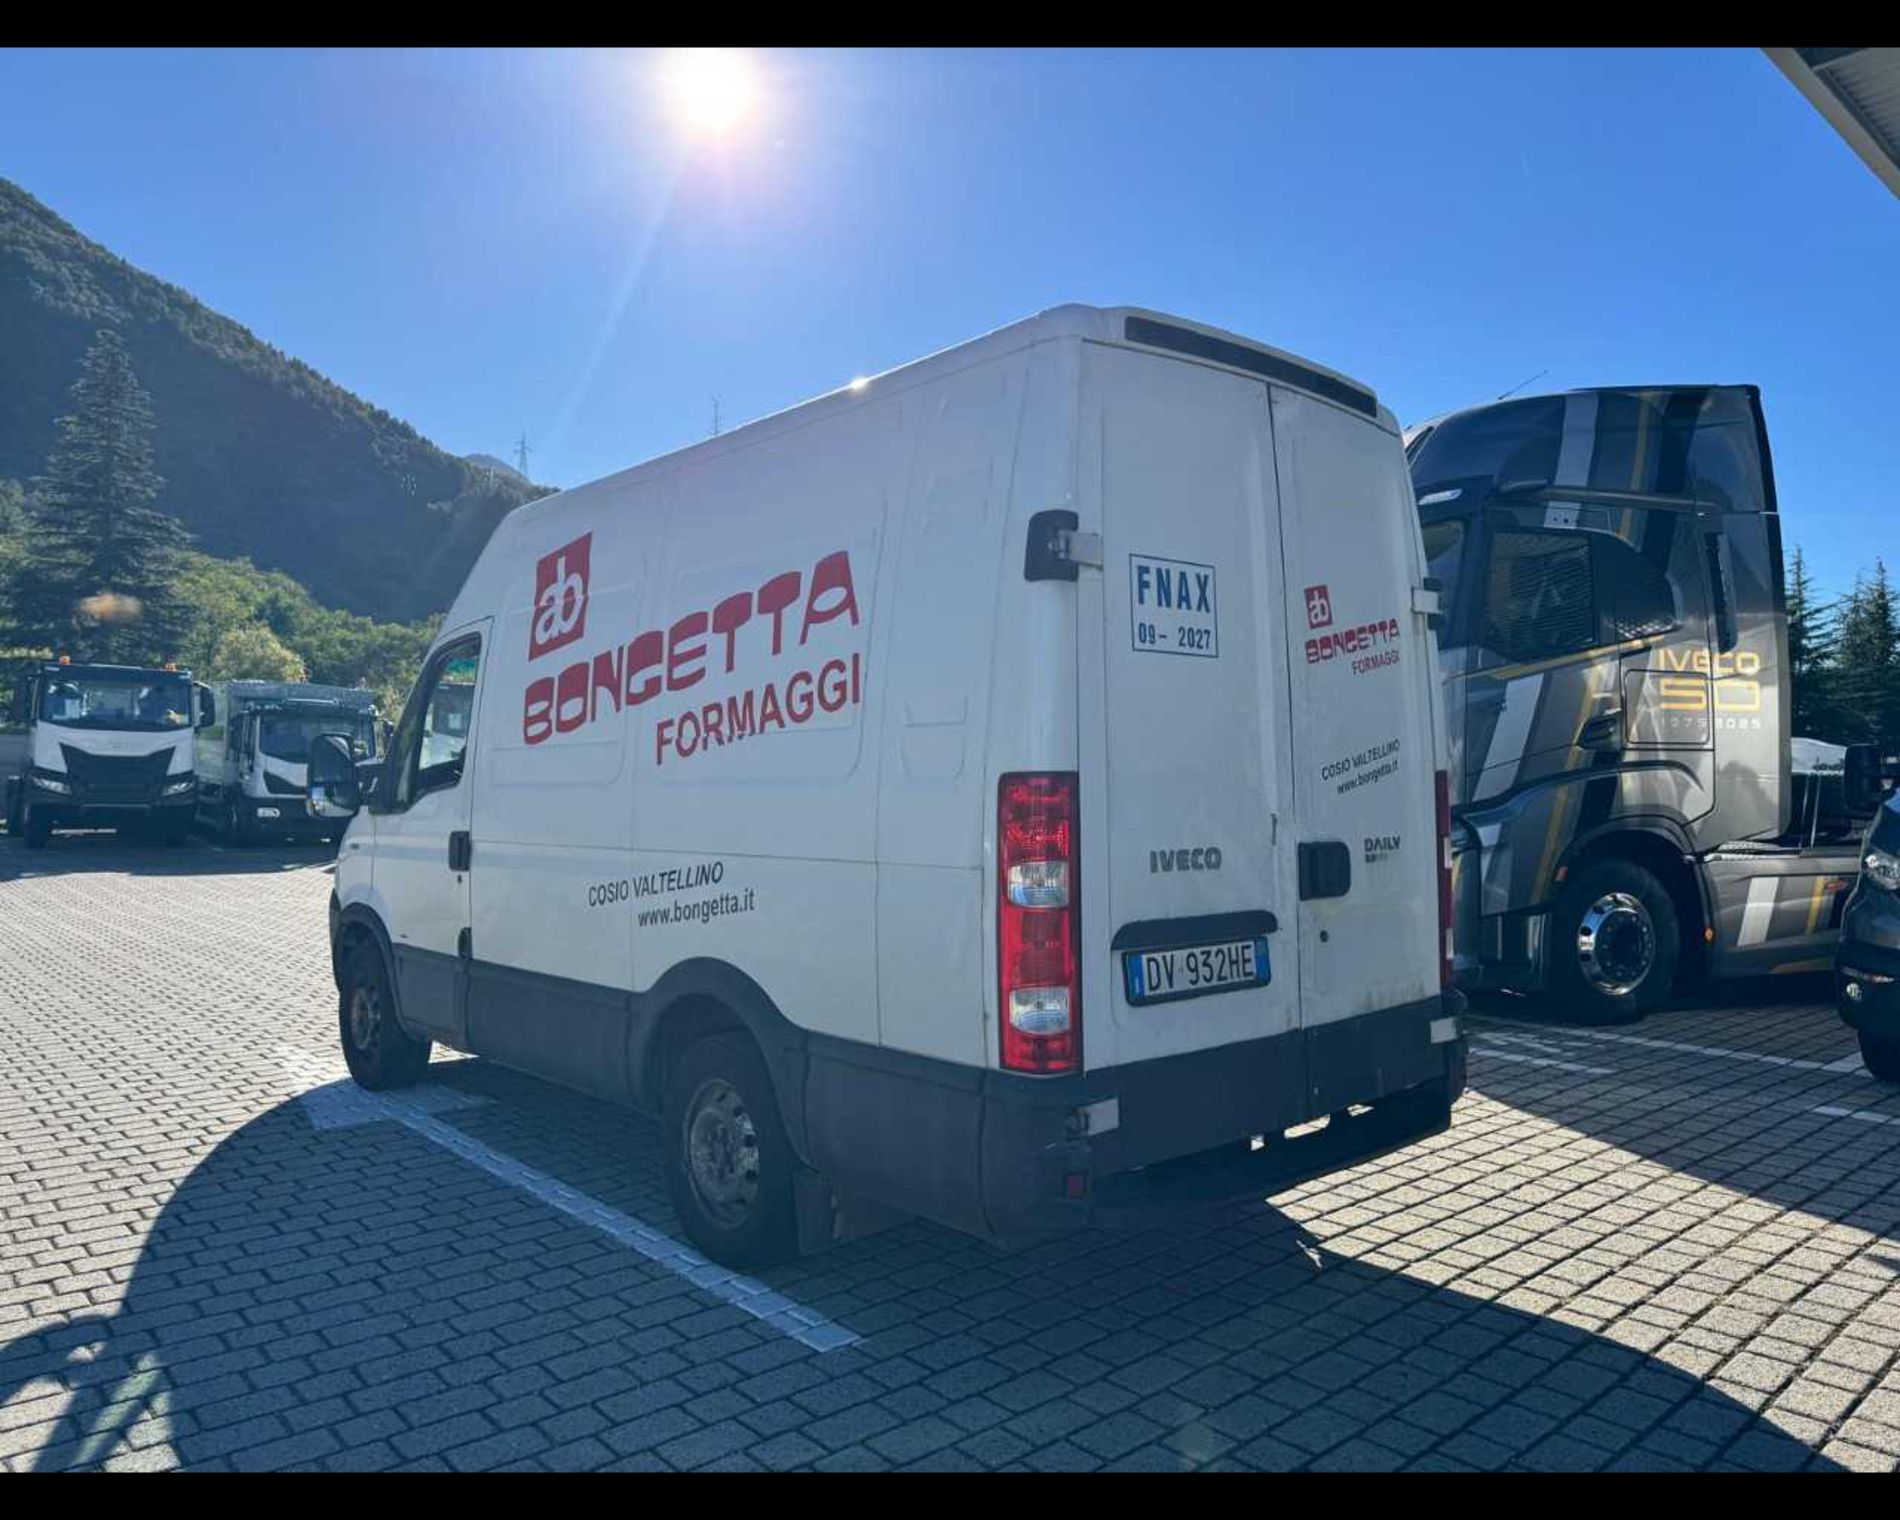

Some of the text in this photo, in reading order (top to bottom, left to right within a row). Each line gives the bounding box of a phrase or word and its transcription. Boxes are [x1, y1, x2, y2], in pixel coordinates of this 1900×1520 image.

[1137, 565, 1210, 613] FNAX
[523, 550, 859, 745] BONGETTA
[1179, 626, 1211, 650] 2027
[1658, 647, 1761, 674] IVECO
[656, 652, 860, 765] FORMAGGI
[1660, 676, 1761, 711] 50
[1321, 757, 1350, 781] COSIO
[1150, 846, 1222, 873] IVECO
[1364, 836, 1401, 851] DAILY
[588, 861, 724, 907] COSIO VALTELLINO
[638, 888, 755, 927] www.bongetta.it
[1146, 944, 1255, 992] DV 932HE
